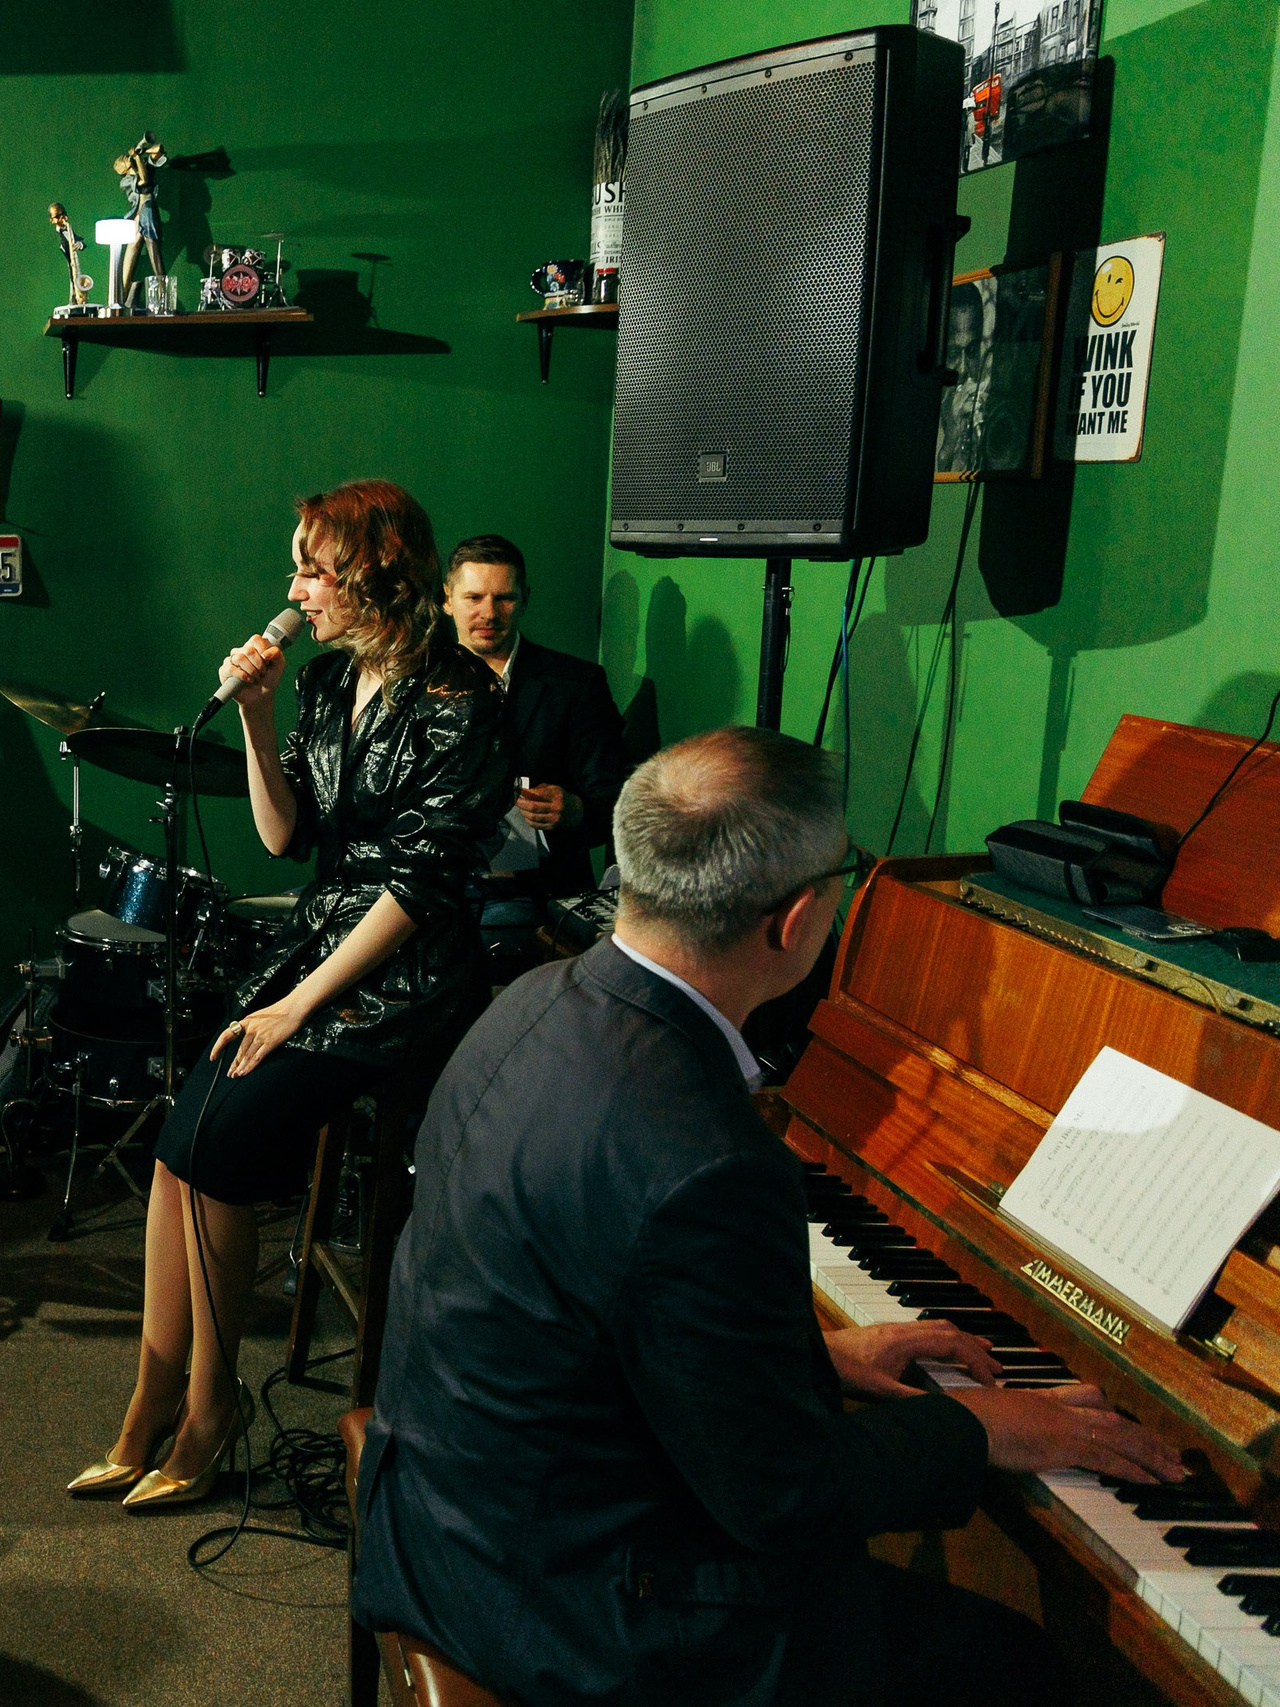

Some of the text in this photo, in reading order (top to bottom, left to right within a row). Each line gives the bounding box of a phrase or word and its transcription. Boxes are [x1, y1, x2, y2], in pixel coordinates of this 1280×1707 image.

[1091, 372, 1132, 409] YOU
[1067, 410, 1128, 435] ANT ME
[706, 461, 721, 472] JBL
[1021, 1259, 1130, 1340] ZIMMERMANN
